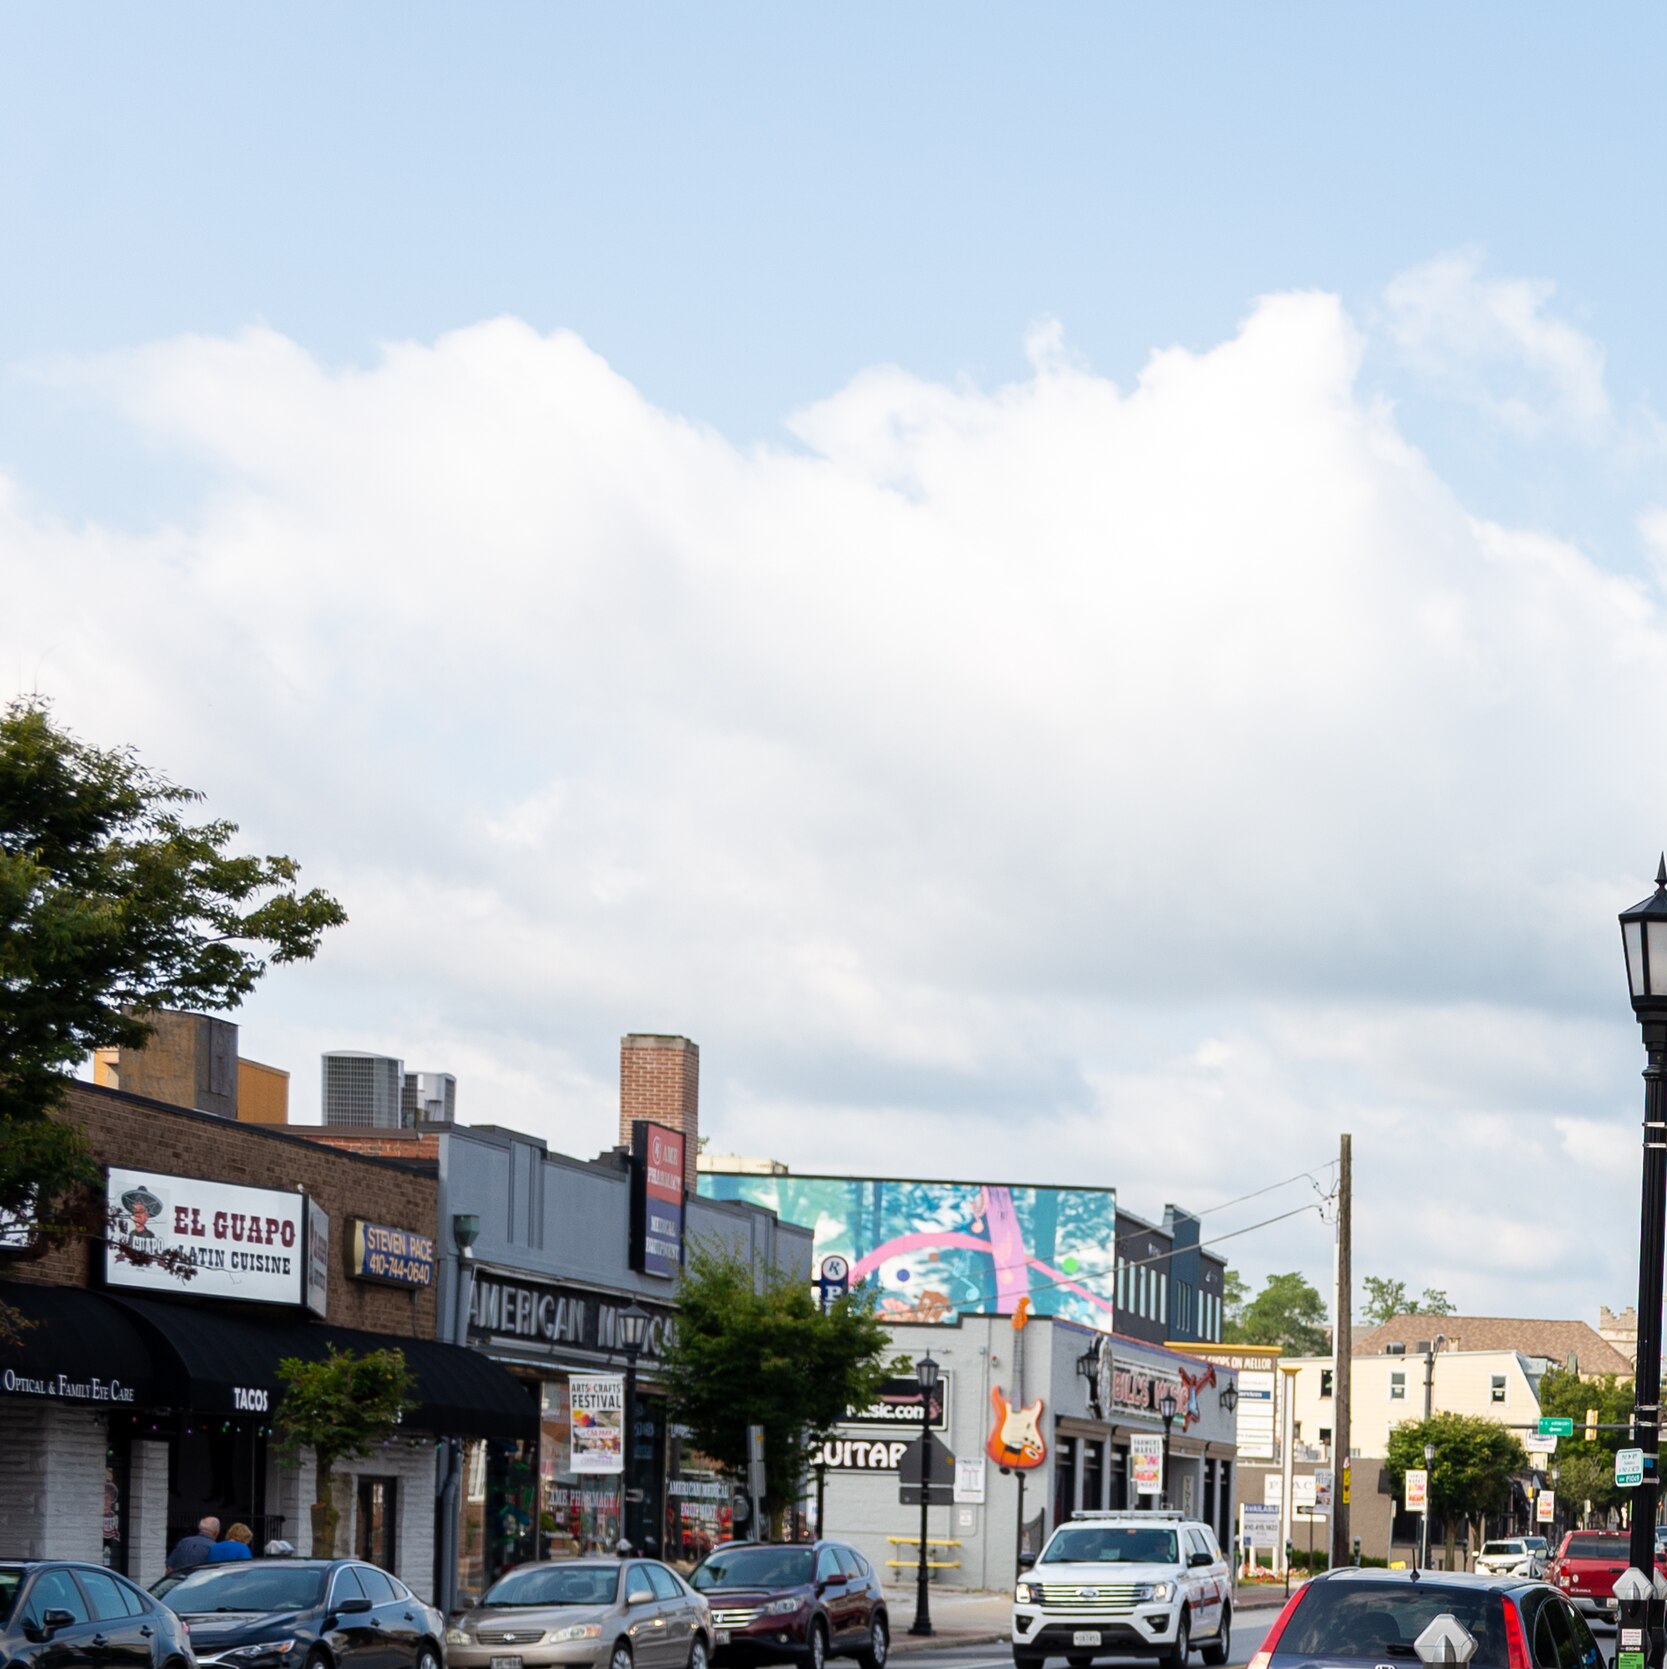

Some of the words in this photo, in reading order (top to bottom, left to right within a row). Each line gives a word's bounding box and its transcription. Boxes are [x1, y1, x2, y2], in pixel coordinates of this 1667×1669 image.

[647, 1166, 681, 1191] PHARMACY
[174, 1205, 205, 1237] EL
[213, 1211, 297, 1248] GUAPO
[650, 1215, 676, 1237] MEDICAL
[367, 1229, 407, 1255] STEVEN
[409, 1235, 433, 1262] PACE
[646, 1237, 680, 1260] EQUIPMENT
[178, 1244, 226, 1268] LATIN
[231, 1252, 291, 1275] CUISINE
[369, 1253, 430, 1286] 410-744-0640
[467, 1280, 585, 1343] AMERICAN
[1231, 1357, 1243, 1369] ON
[1243, 1358, 1272, 1370] MELLOR
[48, 1381, 56, 1395] &
[58, 1374, 91, 1398] FAMILY
[92, 1377, 109, 1400] EYE
[110, 1380, 134, 1402] CARE
[234, 1387, 268, 1412] TACOS
[572, 1394, 621, 1408] FESTIVAL
[569, 1489, 615, 1508] PHARMACY
[1245, 1505, 1279, 1513] AVAILABLE
